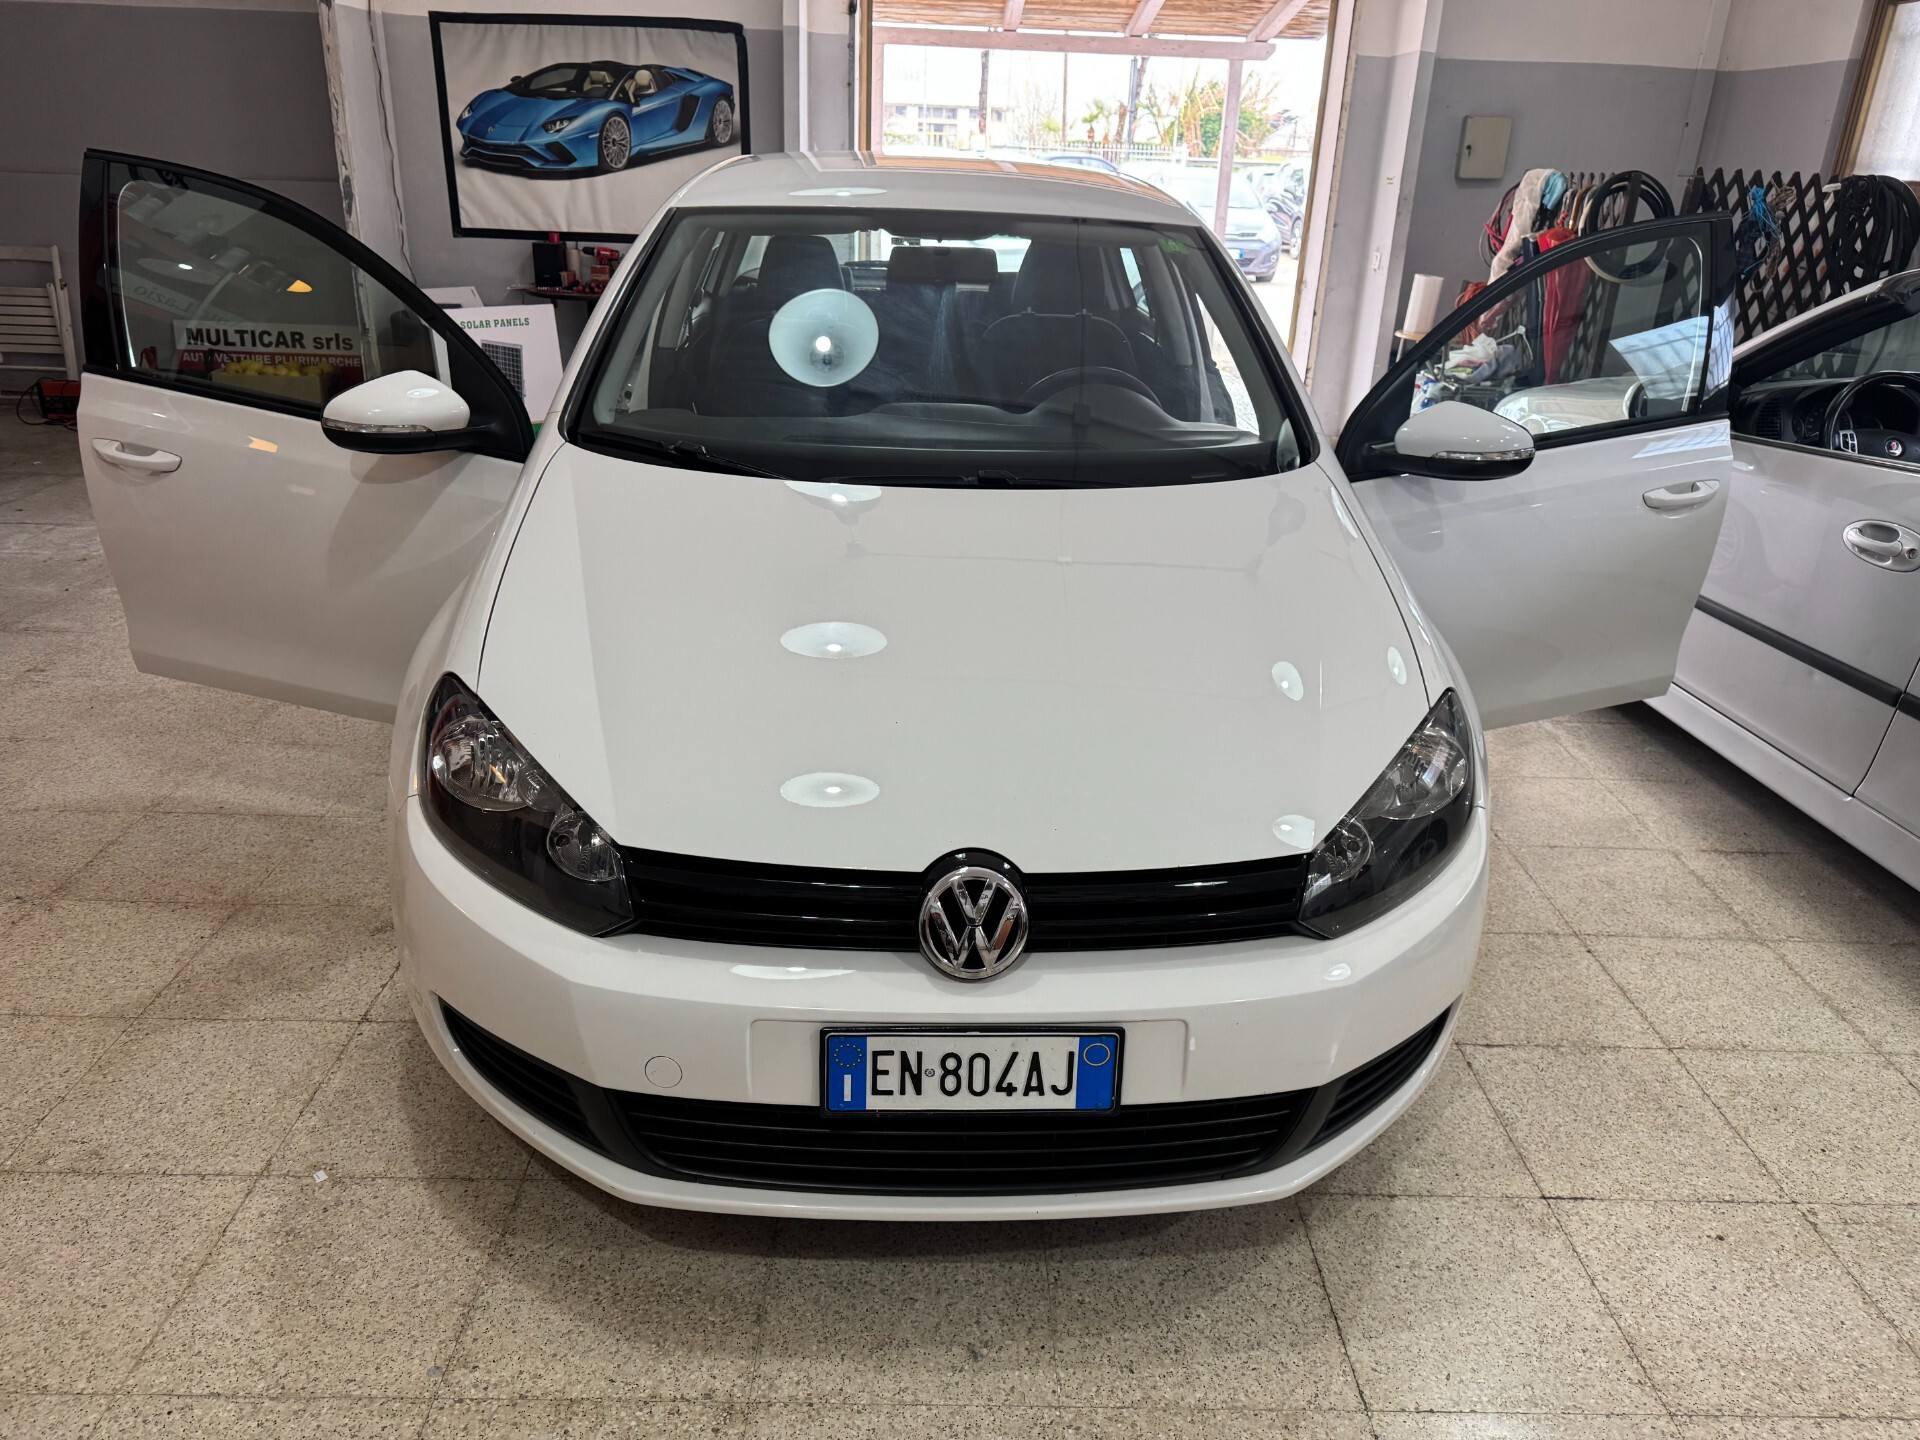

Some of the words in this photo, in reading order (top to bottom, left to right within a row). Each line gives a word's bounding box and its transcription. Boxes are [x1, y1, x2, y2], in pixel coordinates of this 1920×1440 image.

[460, 319, 491, 330] SOLAR
[494, 317, 530, 328] PANELS
[186, 327, 306, 349] MULTICAR
[312, 333, 353, 351] srls
[182, 352, 272, 365] AUTVETTURE
[924, 870, 1025, 976] VW
[843, 1074, 852, 1102] I
